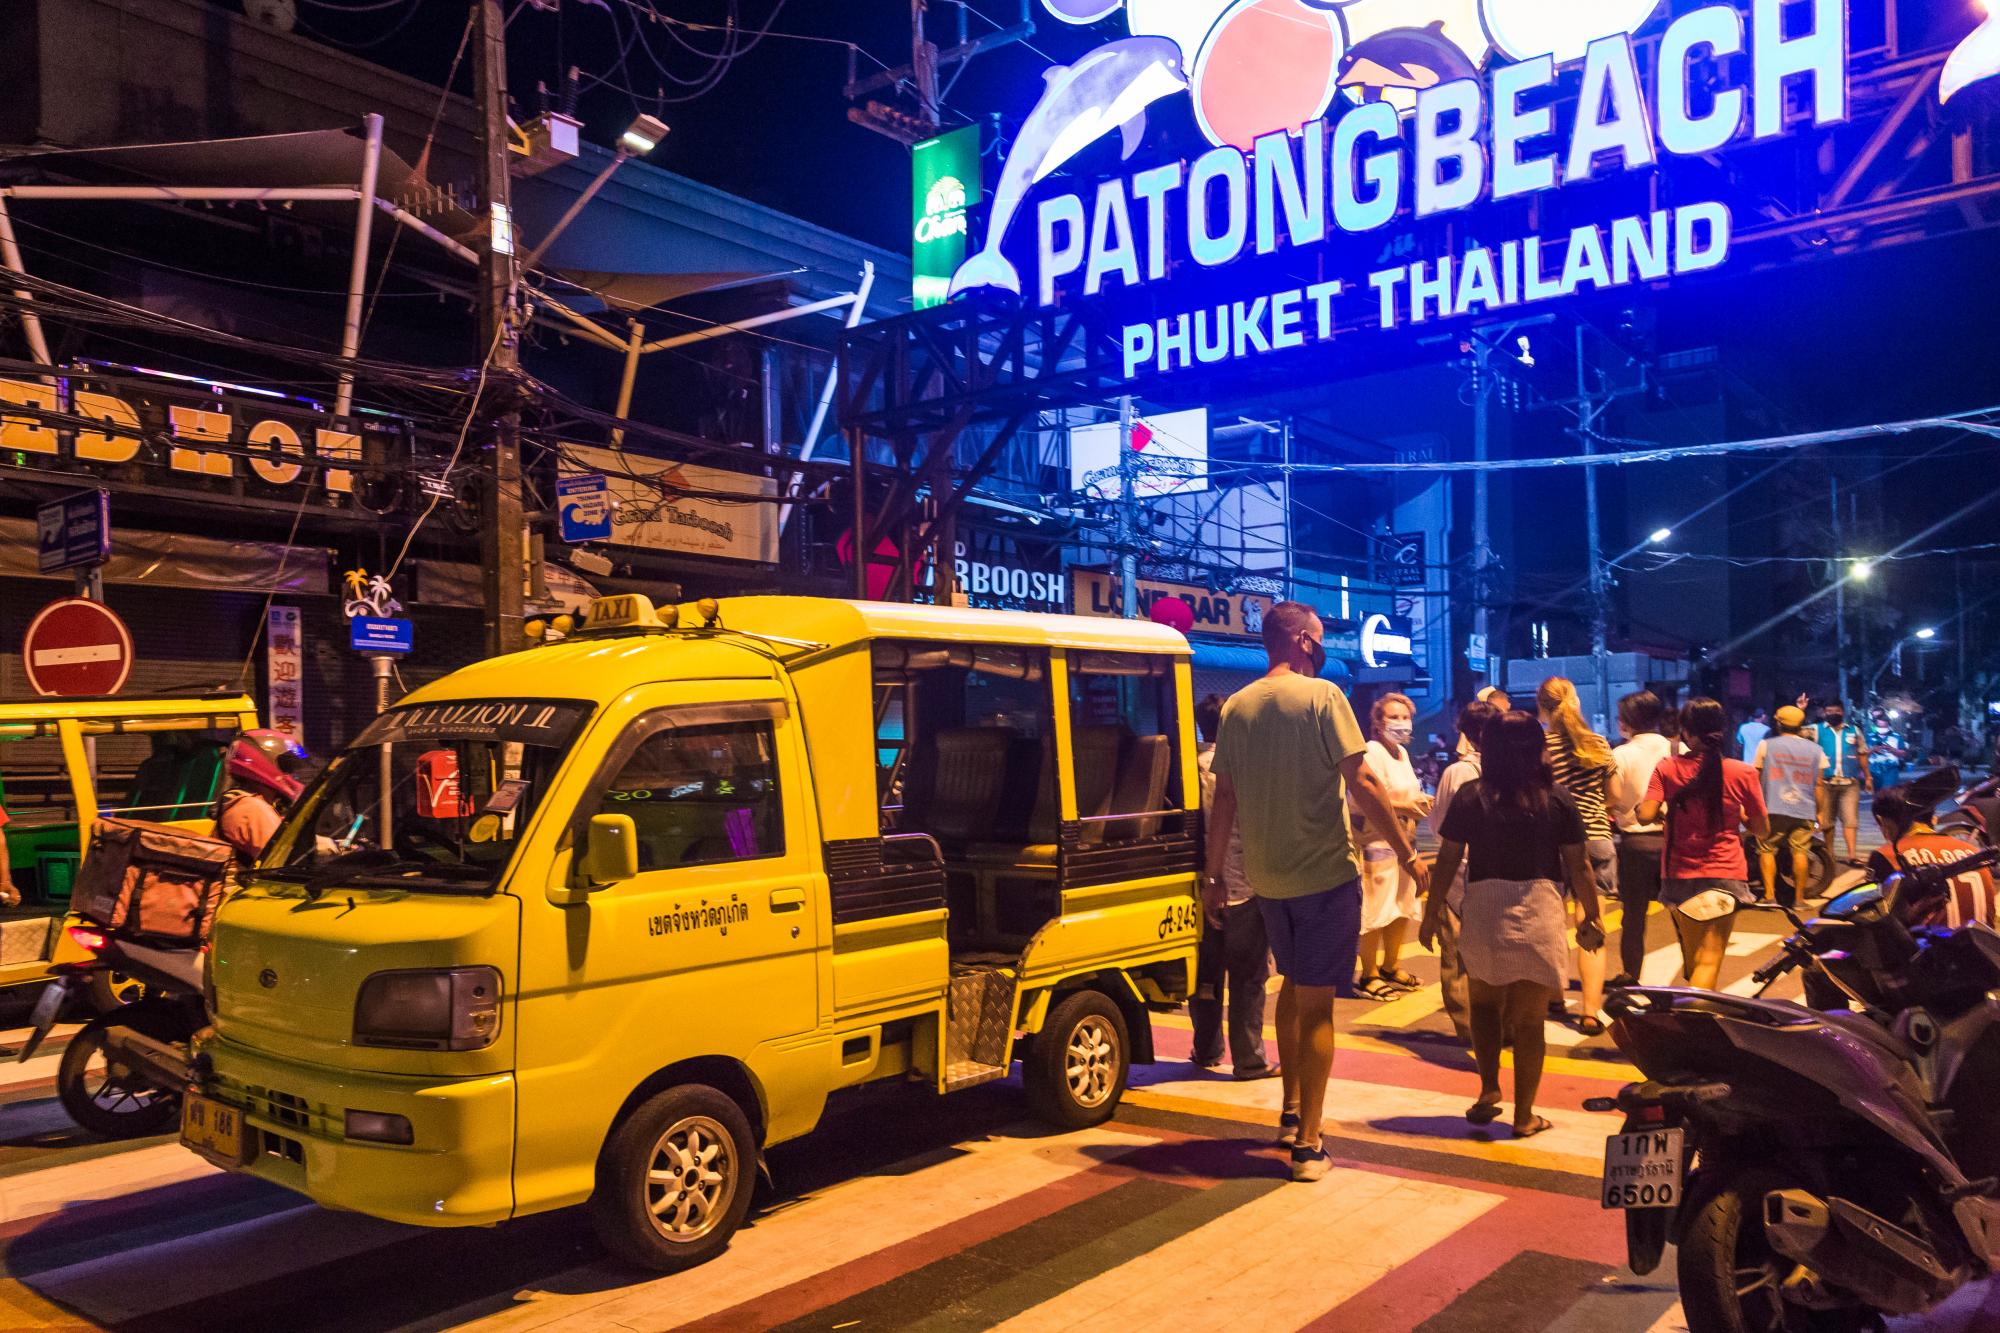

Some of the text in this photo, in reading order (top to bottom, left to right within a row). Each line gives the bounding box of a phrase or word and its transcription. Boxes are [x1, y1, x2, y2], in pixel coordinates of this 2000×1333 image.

[1122, 203, 1729, 379] PHUKET THAILAND
[169, 405, 363, 493] HOT
[591, 598, 632, 621] TAXI
[648, 893, 749, 936] เขตจังหวัดภูเก็ต
[1607, 1183, 1673, 1206] 6500
